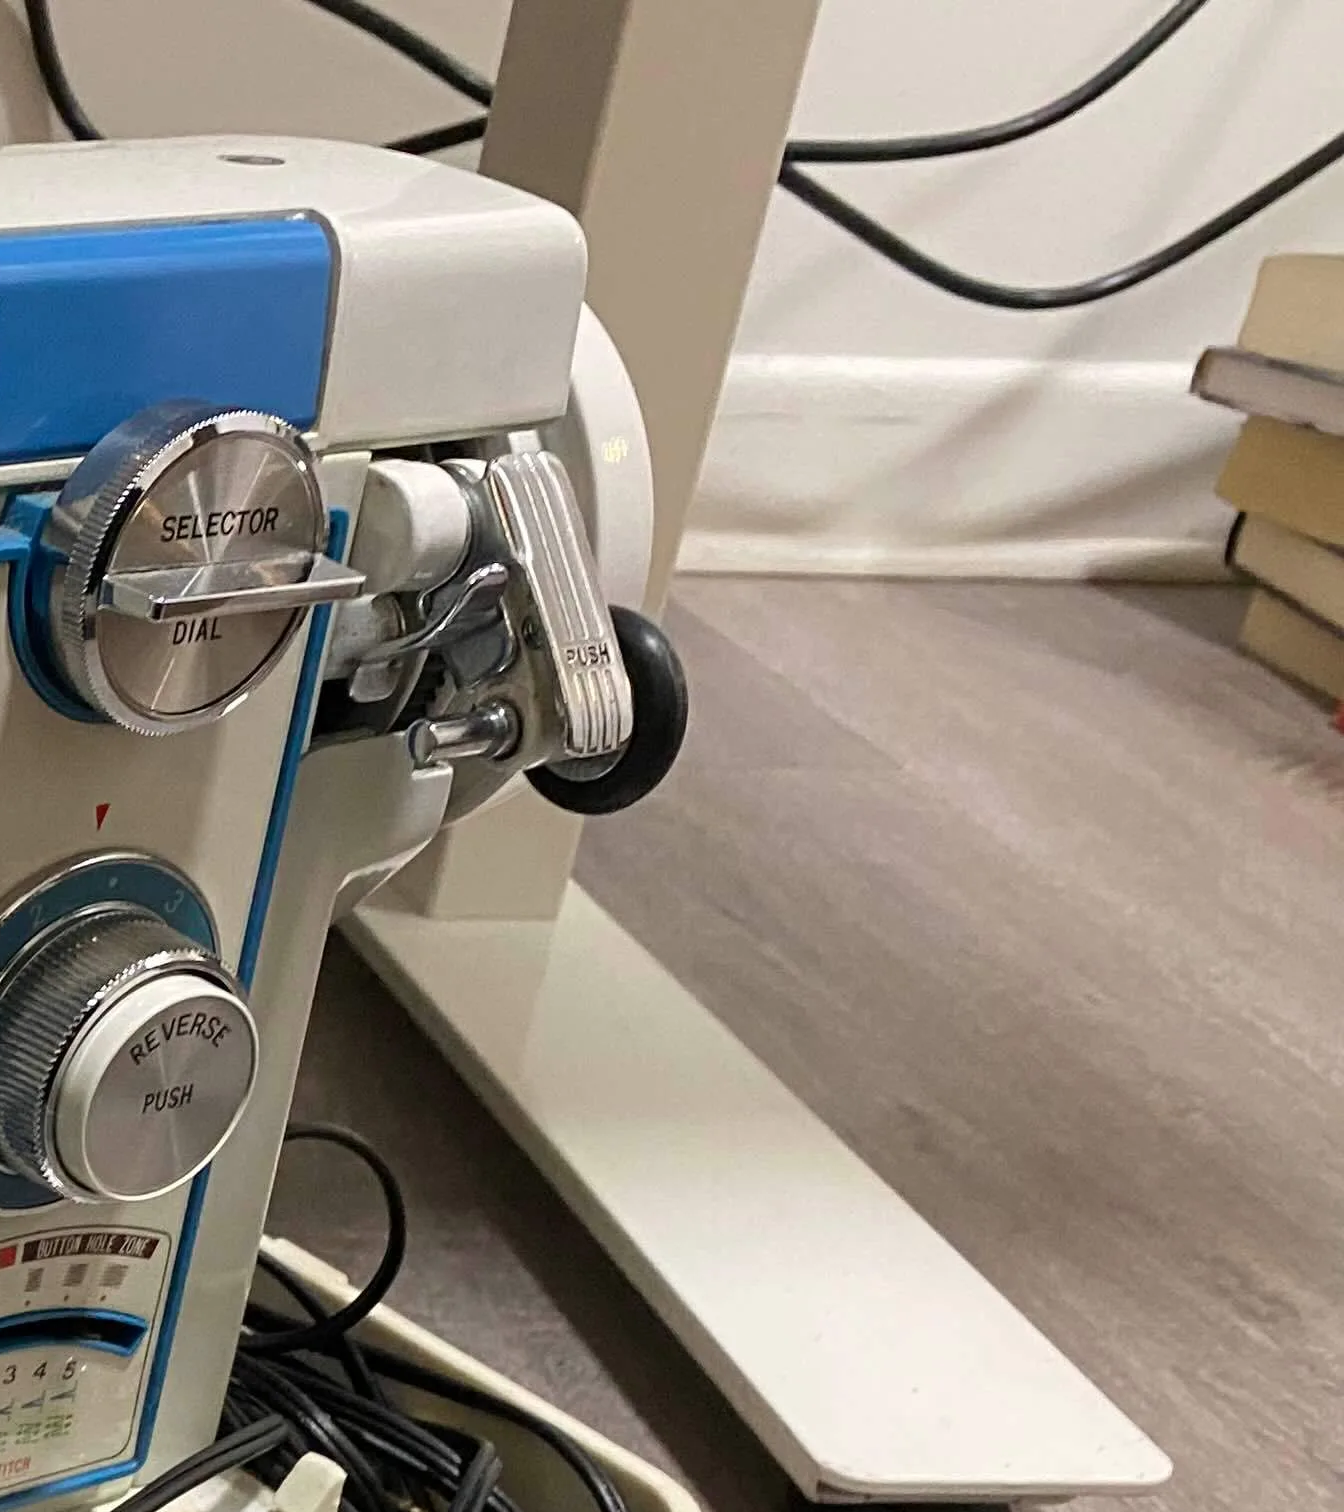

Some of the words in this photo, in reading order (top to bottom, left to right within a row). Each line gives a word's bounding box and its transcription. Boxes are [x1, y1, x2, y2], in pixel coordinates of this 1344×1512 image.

[160, 506, 279, 543] SELECTOR
[171, 617, 223, 645] DIAL
[565, 642, 611, 666] PUSH
[128, 1011, 233, 1066] REVERSE
[141, 1083, 194, 1114] PUSH
[37, 1237, 82, 1257] BUTTON
[88, 1235, 114, 1253] HOLE
[118, 1237, 150, 1256] ZONE
[2, 1364, 17, 1385] 3
[32, 1360, 48, 1380] 4
[61, 1358, 78, 1381] 5
